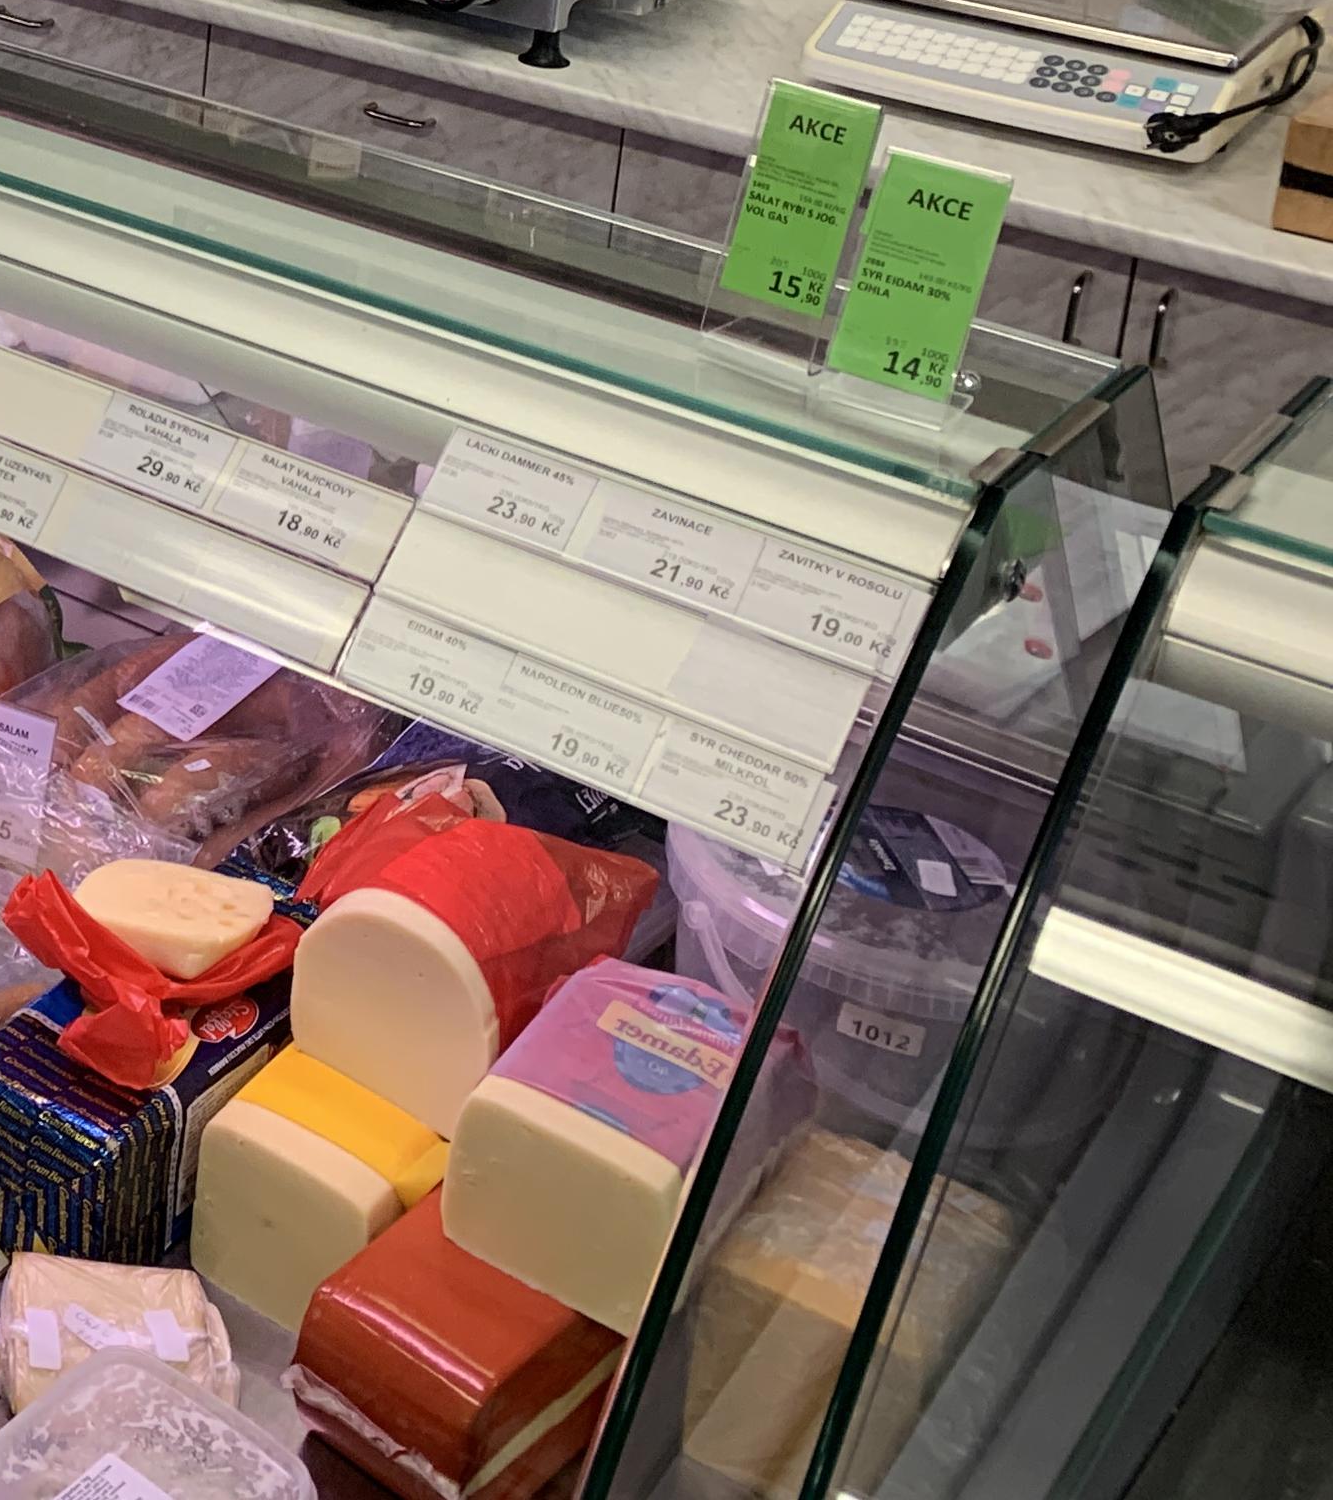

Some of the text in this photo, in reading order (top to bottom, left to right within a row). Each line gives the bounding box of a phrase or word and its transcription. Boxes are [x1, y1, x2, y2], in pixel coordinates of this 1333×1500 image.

[789, 114, 847, 146] AKCE
[745, 203, 789, 226] VOL GAS
[748, 190, 839, 228] SALAT RYBI JOG.
[907, 188, 974, 222] AKCE
[808, 280, 825, 295] Kč
[856, 280, 890, 299] CIHLA
[862, 266, 884, 282] SYR
[885, 273, 925, 295] EIDAM
[928, 362, 946, 375] Kč
[128, 404, 210, 444] ROLADA SYROVA
[144, 425, 182, 446] VAHALA
[466, 438, 499, 457] LACKI
[501, 450, 551, 477] DAMMER
[184, 479, 202, 494] Kč
[262, 454, 356, 499] SALAT VAJICKOVY
[282, 477, 321, 499] VAHALA
[17, 515, 34, 529] Kč
[541, 520, 560, 537] Kč
[652, 508, 714, 536] ZAVINACE
[324, 532, 341, 549] Kč
[779, 549, 903, 601] ZAVITKY V ROSOLU
[709, 583, 730, 600] Kč
[407, 619, 443, 642] EIDAM
[869, 638, 891, 658] Kč
[520, 665, 587, 699] NAPOLEON
[459, 698, 479, 714] Kč
[690, 732, 716, 748] SYR
[718, 743, 782, 777] CHEDDAR
[605, 763, 626, 779] Kč
[714, 758, 770, 789] MILKPOL
[852, 1019, 912, 1050] 1012
